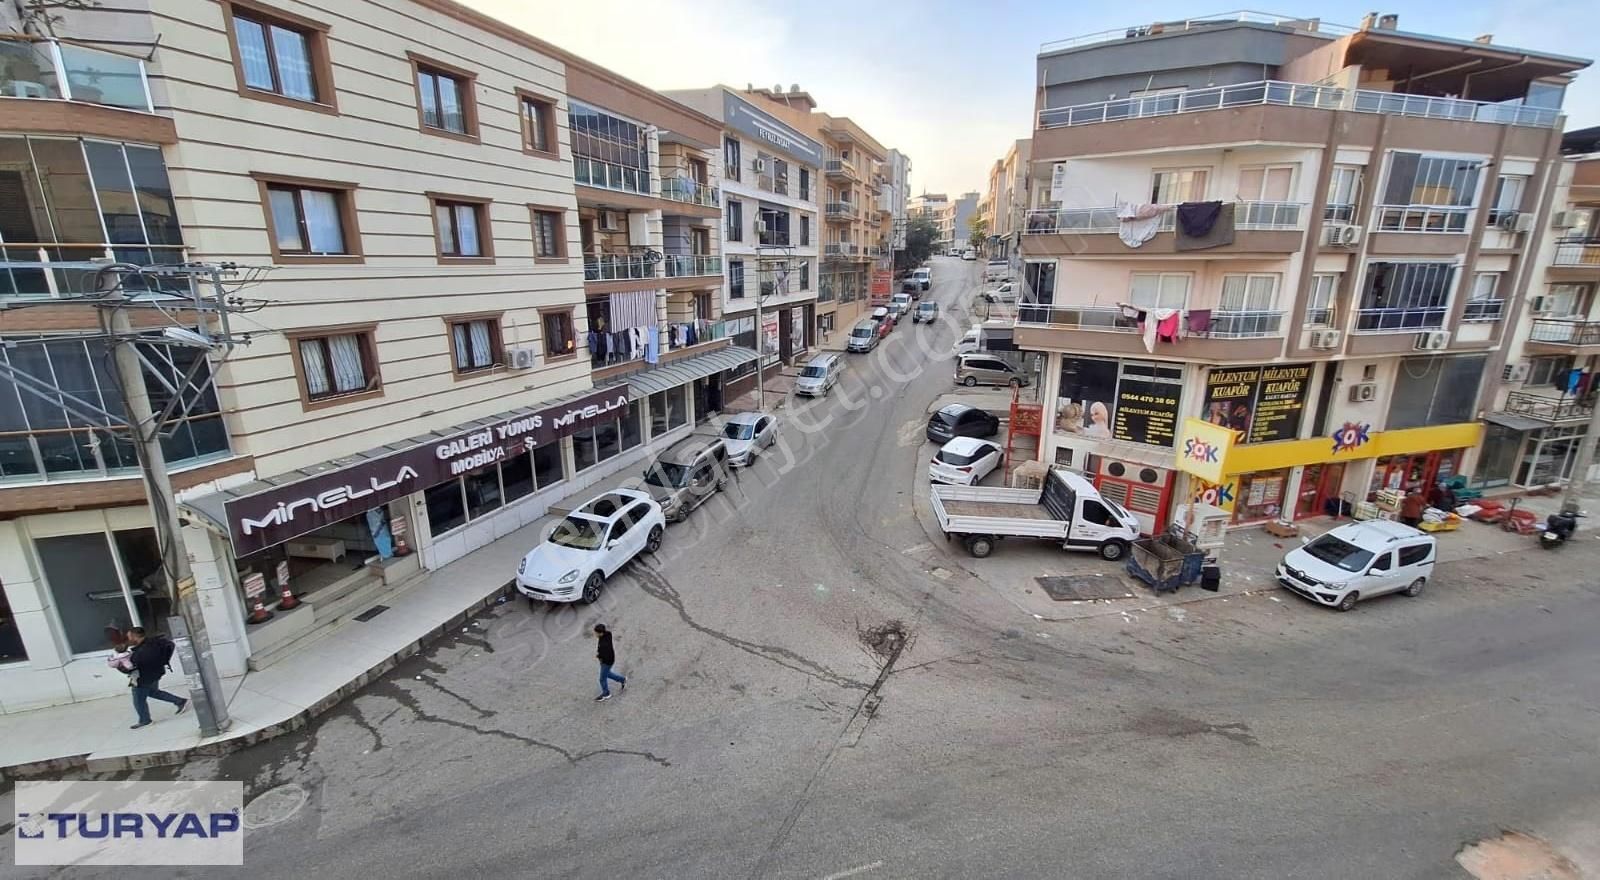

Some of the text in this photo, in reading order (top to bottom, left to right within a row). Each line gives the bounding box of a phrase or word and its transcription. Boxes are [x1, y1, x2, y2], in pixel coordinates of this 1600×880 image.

[1121, 393, 1139, 401] 0544
[436, 415, 543, 460] GALERİ YUNUS
[450, 446, 505, 475] MOBİLYA
